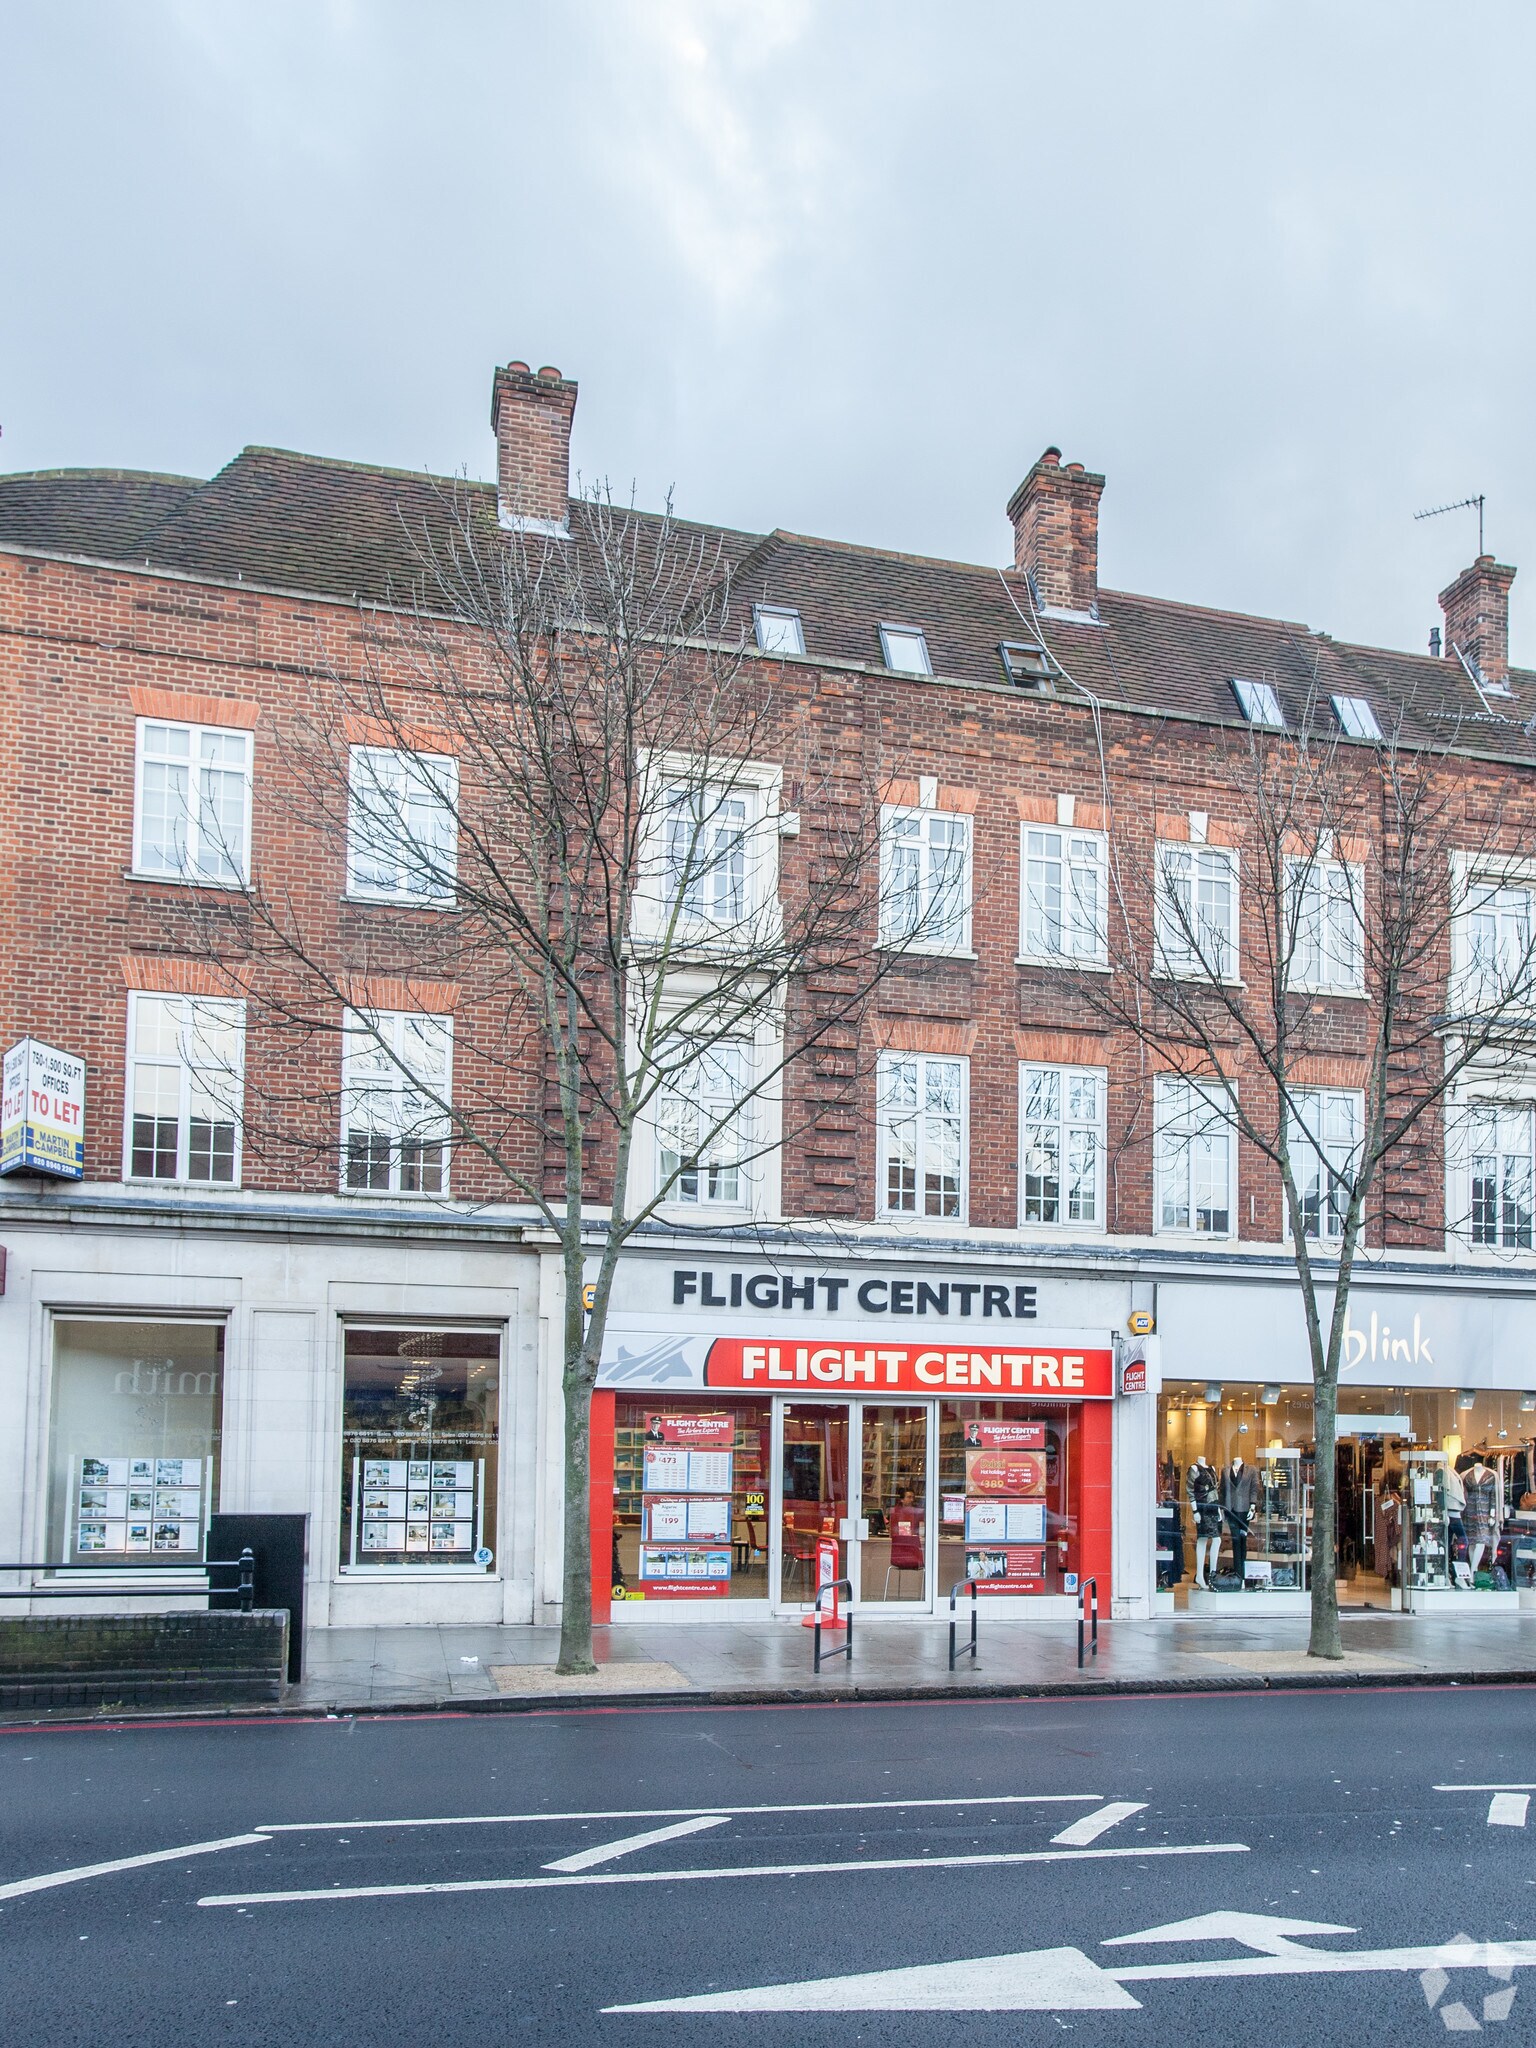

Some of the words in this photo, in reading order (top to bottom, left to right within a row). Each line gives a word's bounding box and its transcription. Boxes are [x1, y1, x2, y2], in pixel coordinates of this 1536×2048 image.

[42, 1074, 69, 1095] OFFICES
[31, 1090, 49, 1116] TO
[54, 1098, 80, 1125] LET
[39, 1131, 70, 1149] MARTIN
[34, 1140, 75, 1161] CAMPBELL
[33, 1159, 45, 1167] 020
[46, 1161, 61, 1171] 8940
[673, 1270, 849, 1312] FLIGHT
[857, 1279, 1038, 1319] CENTRE
[1341, 1304, 1434, 1372] blink
[742, 1346, 908, 1384] FLIGHT
[914, 1352, 1085, 1388] CENTRE
[1126, 1371, 1145, 1381] FLIGHT
[1125, 1381, 1146, 1391] CENTRE
[667, 1419, 697, 1427] FLIGHT
[697, 1420, 729, 1428] CENTRE
[980, 1459, 1006, 1469] Dubai
[980, 1479, 1005, 1489] £389
[746, 1494, 765, 1504] 100
